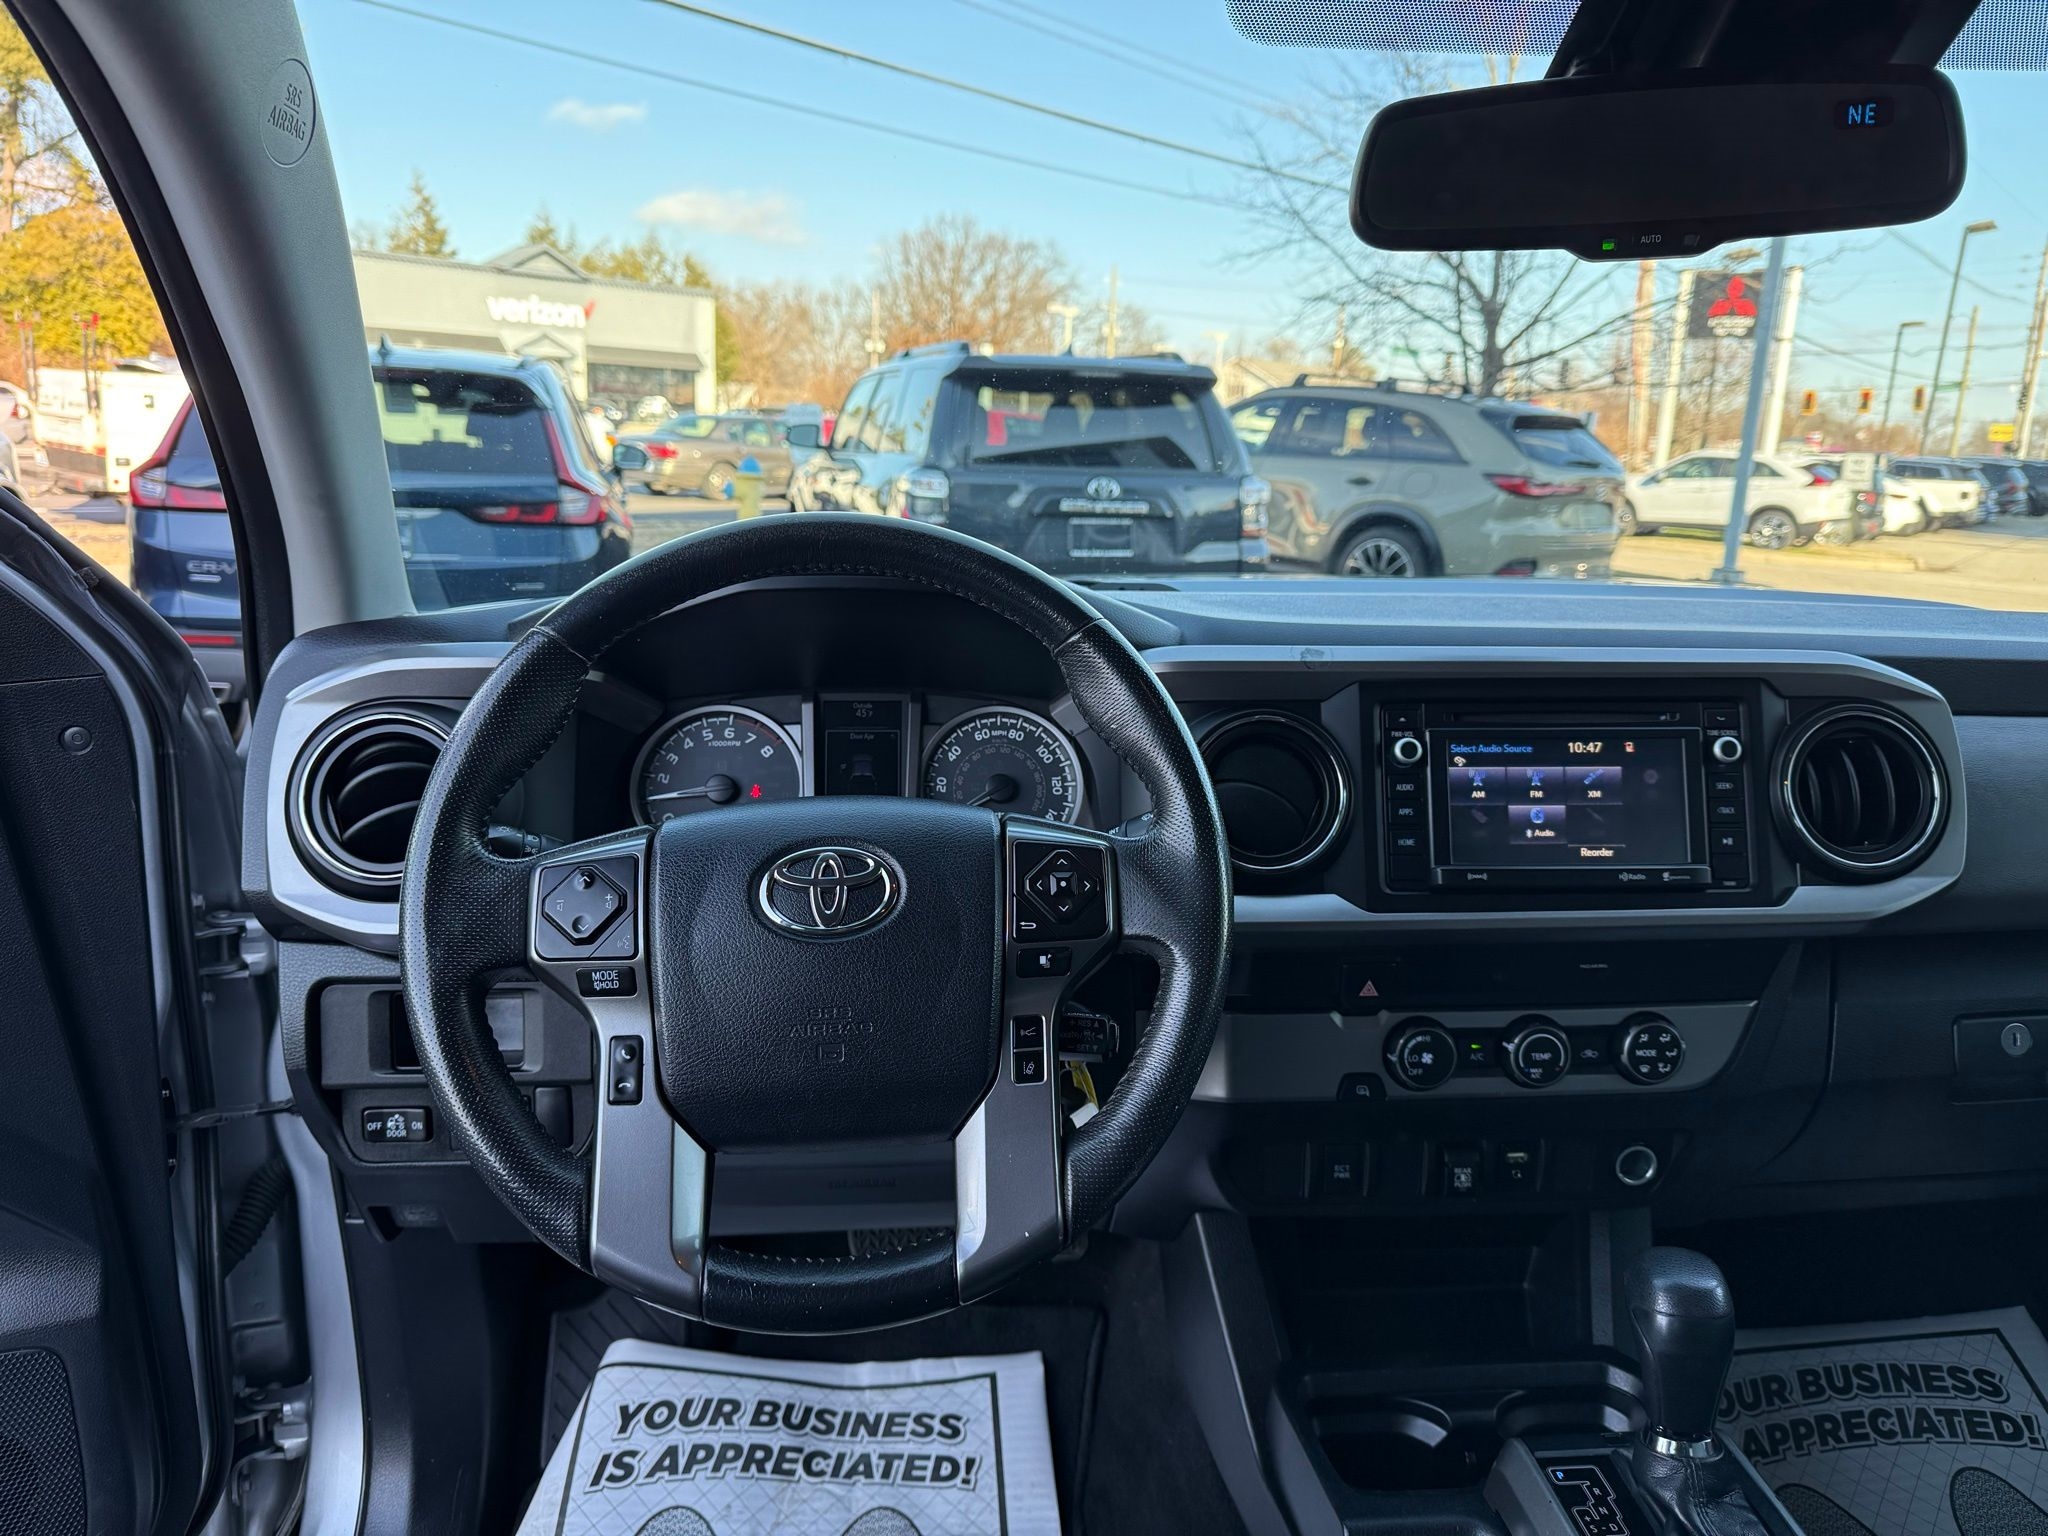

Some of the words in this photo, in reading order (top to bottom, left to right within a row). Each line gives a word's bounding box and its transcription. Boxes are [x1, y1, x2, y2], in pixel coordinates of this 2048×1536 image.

[285, 83, 302, 108] SRS
[1848, 103, 1877, 125] NE
[266, 104, 306, 141] AIRBAG
[1640, 234, 1662, 244] AUTO
[484, 293, 588, 329] verizon
[702, 728, 714, 741] 5
[724, 727, 735, 739] 6
[745, 732, 757, 744] 7
[974, 728, 990, 742] 60
[1008, 728, 1025, 742] 80
[683, 737, 695, 750] 4
[1450, 743, 1476, 753] Select
[1477, 743, 1501, 753] Audio
[1503, 743, 1533, 753] Source
[1568, 741, 1603, 753] 10:47
[760, 744, 774, 759] 8
[947, 745, 962, 763] 40
[1034, 744, 1054, 764] 100
[666, 752, 679, 765] 3
[657, 772, 670, 784] 2
[936, 776, 947, 793] 20
[1051, 776, 1063, 796] 120
[1395, 783, 1414, 791] AUDIO
[1471, 790, 1486, 799] AM
[1529, 790, 1545, 799] FM
[1587, 790, 1602, 799] XM
[1398, 808, 1414, 816] APPS
[1533, 829, 1556, 838] Audio
[1397, 838, 1416, 846] HOME
[1580, 847, 1614, 857] Reorder
[591, 970, 619, 981] MODE
[599, 980, 620, 989] HOLD
[787, 1021, 874, 1037] AIRBAG
[1408, 1053, 1419, 1062] LO
[1470, 1053, 1485, 1061] A/C
[1531, 1052, 1552, 1061] TEMP
[1635, 1049, 1657, 1057] MODE
[1408, 1067, 1424, 1076] OFF
[367, 1121, 383, 1131] OFF
[411, 1121, 424, 1131] ON
[1797, 1363, 2004, 1400] BUSINESS
[614, 1398, 743, 1437] YOUR
[749, 1401, 965, 1440] BUSINESS
[1742, 1407, 2043, 1460] APPRECIATED!
[589, 1448, 642, 1488] IS
[645, 1442, 979, 1487] APPRECIATED!
[1556, 1471, 1564, 1480] P
[1592, 1487, 1602, 1496] R
[1598, 1506, 1609, 1515] N
[1589, 1524, 1598, 1533] S
[1608, 1523, 1619, 1532] D
